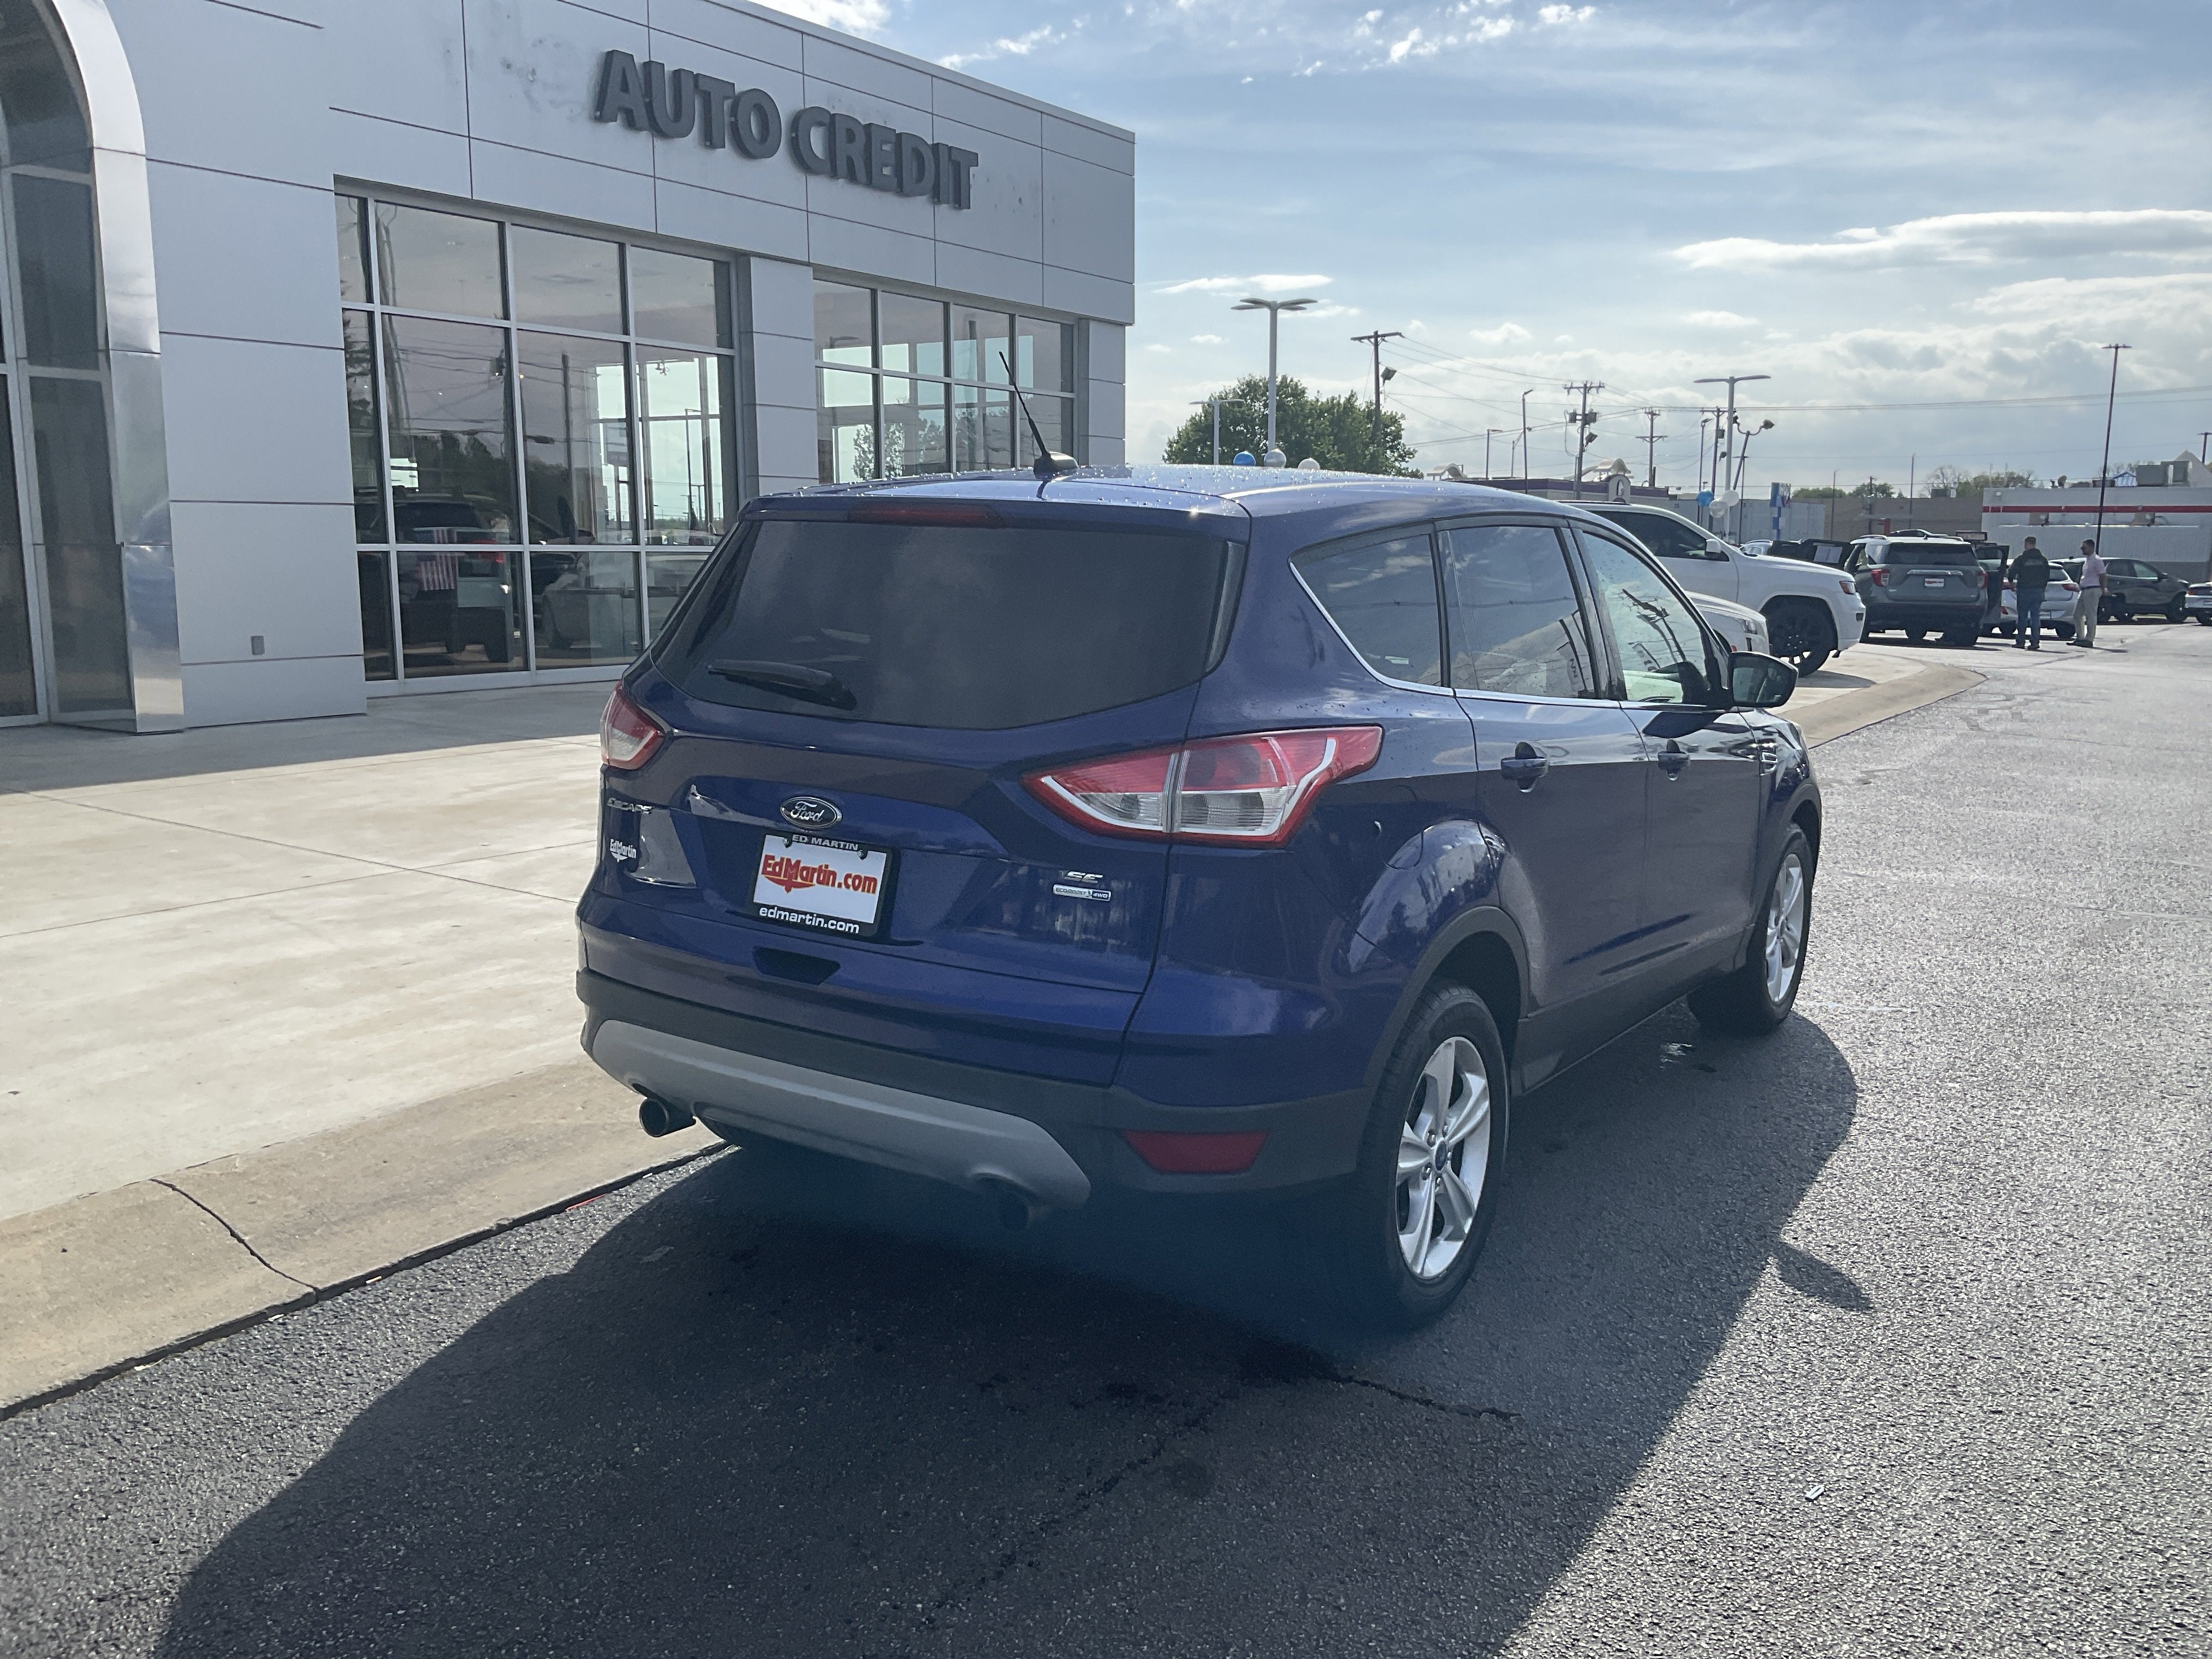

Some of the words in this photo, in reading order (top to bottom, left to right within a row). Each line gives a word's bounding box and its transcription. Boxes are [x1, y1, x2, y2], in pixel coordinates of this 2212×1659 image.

[595, 50, 782, 159] AUTO
[790, 106, 979, 210] CREDIT
[791, 801, 825, 822] Ford
[610, 838, 636, 859] EdMartin
[792, 834, 808, 843] ED
[811, 837, 859, 850] MARTIN
[761, 854, 878, 894] EdMartin.com
[1064, 871, 1103, 884] SE
[759, 907, 860, 934] edmartin.com
